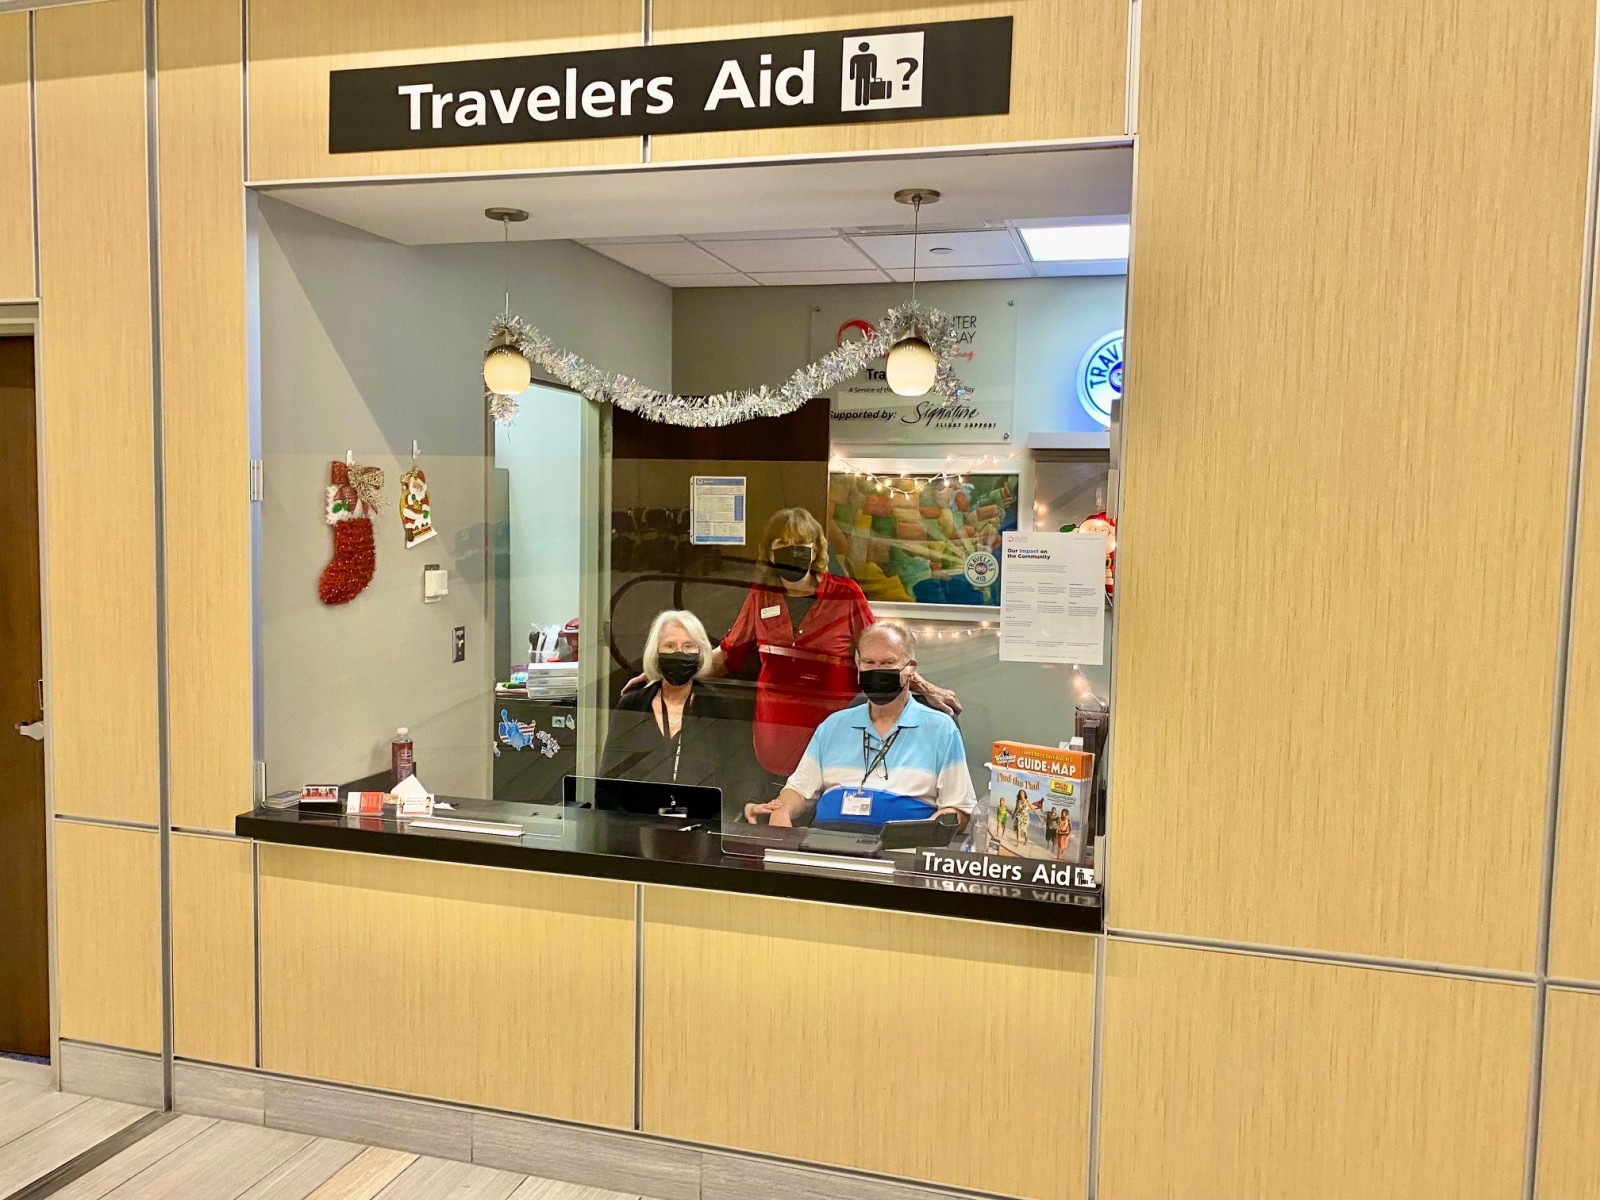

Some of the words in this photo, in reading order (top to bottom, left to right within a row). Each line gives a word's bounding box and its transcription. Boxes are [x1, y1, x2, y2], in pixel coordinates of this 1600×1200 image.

[398, 68, 674, 130] Travelers
[704, 49, 815, 111] Aid
[881, 410, 897, 421] by:
[901, 401, 980, 427] Signature
[967, 555, 995, 572] TRAVELERS
[1017, 757, 1076, 776] GUIDE-MAP
[922, 851, 1022, 881] Travelers
[1031, 863, 1071, 887] Aid
